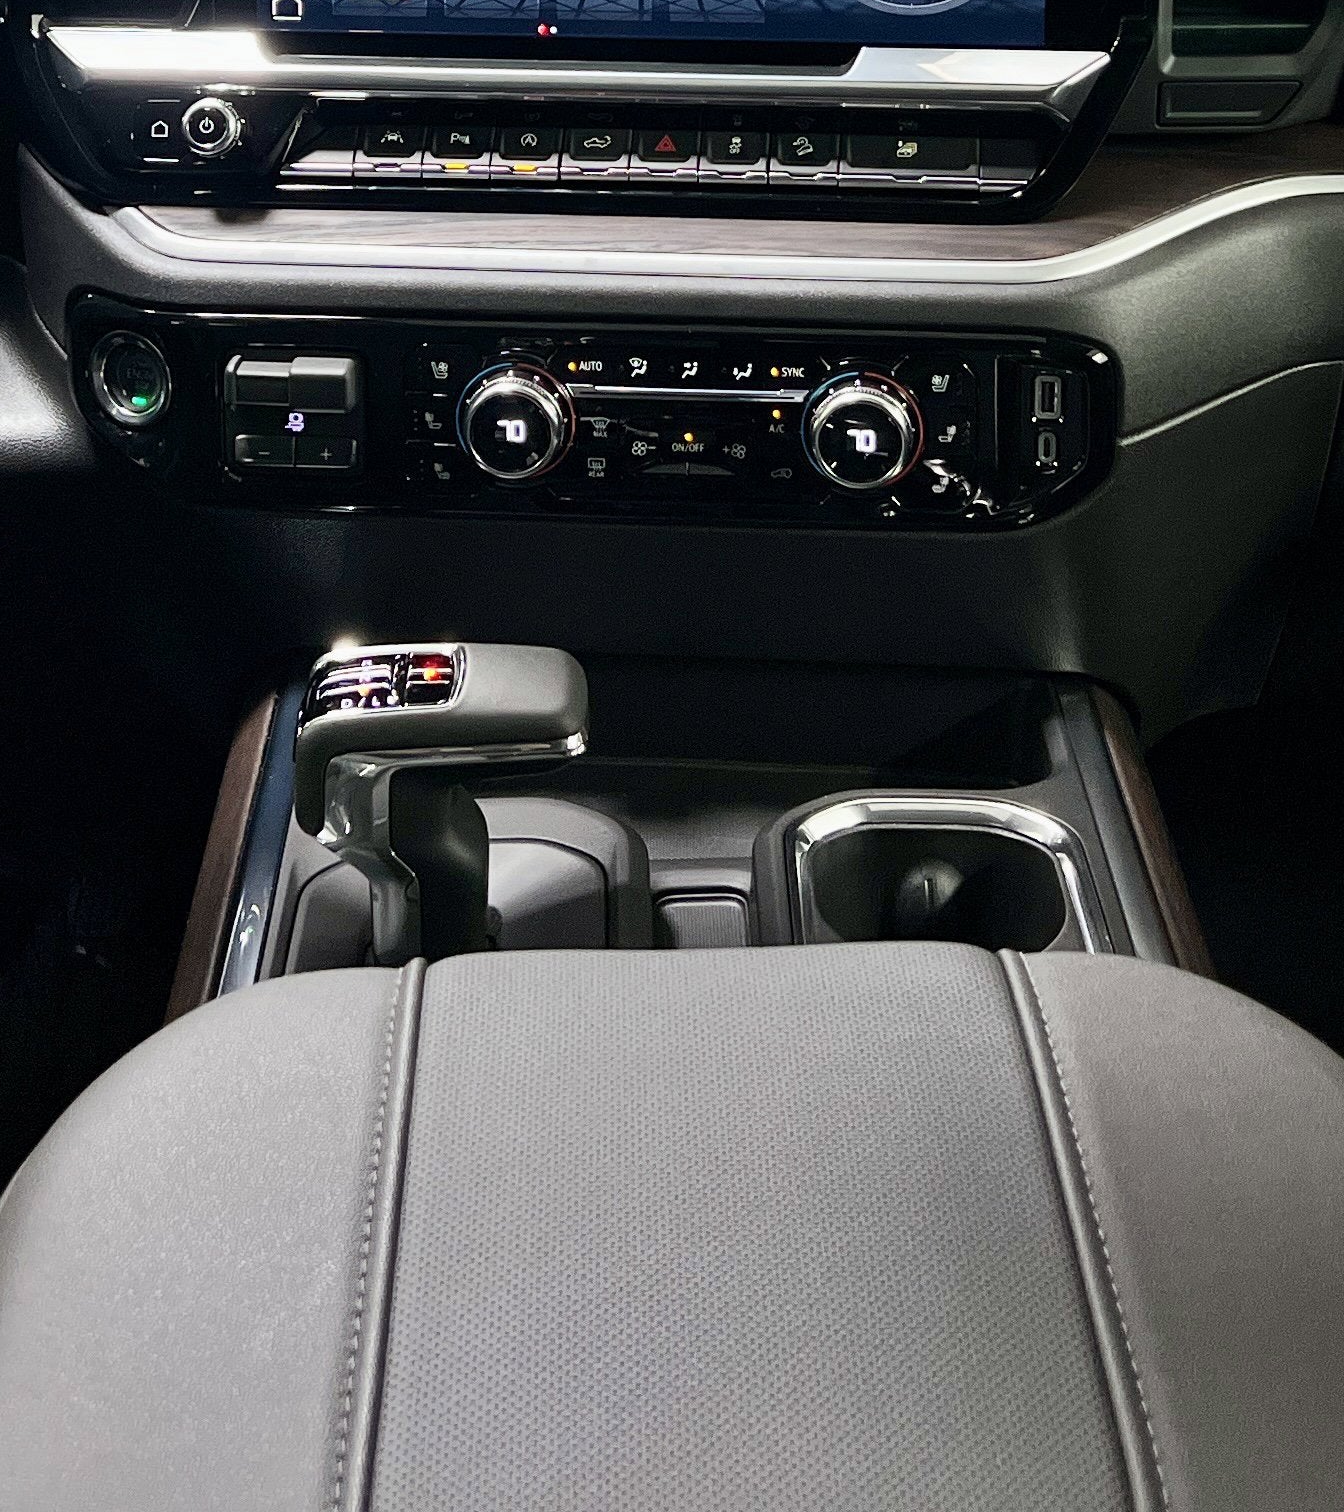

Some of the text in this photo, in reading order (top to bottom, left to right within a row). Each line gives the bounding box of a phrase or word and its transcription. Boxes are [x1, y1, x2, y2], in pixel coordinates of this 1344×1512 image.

[579, 360, 603, 372] AUTO
[781, 367, 805, 378] SYNC
[769, 424, 784, 433] A/C
[671, 443, 704, 453] ON/OFF
